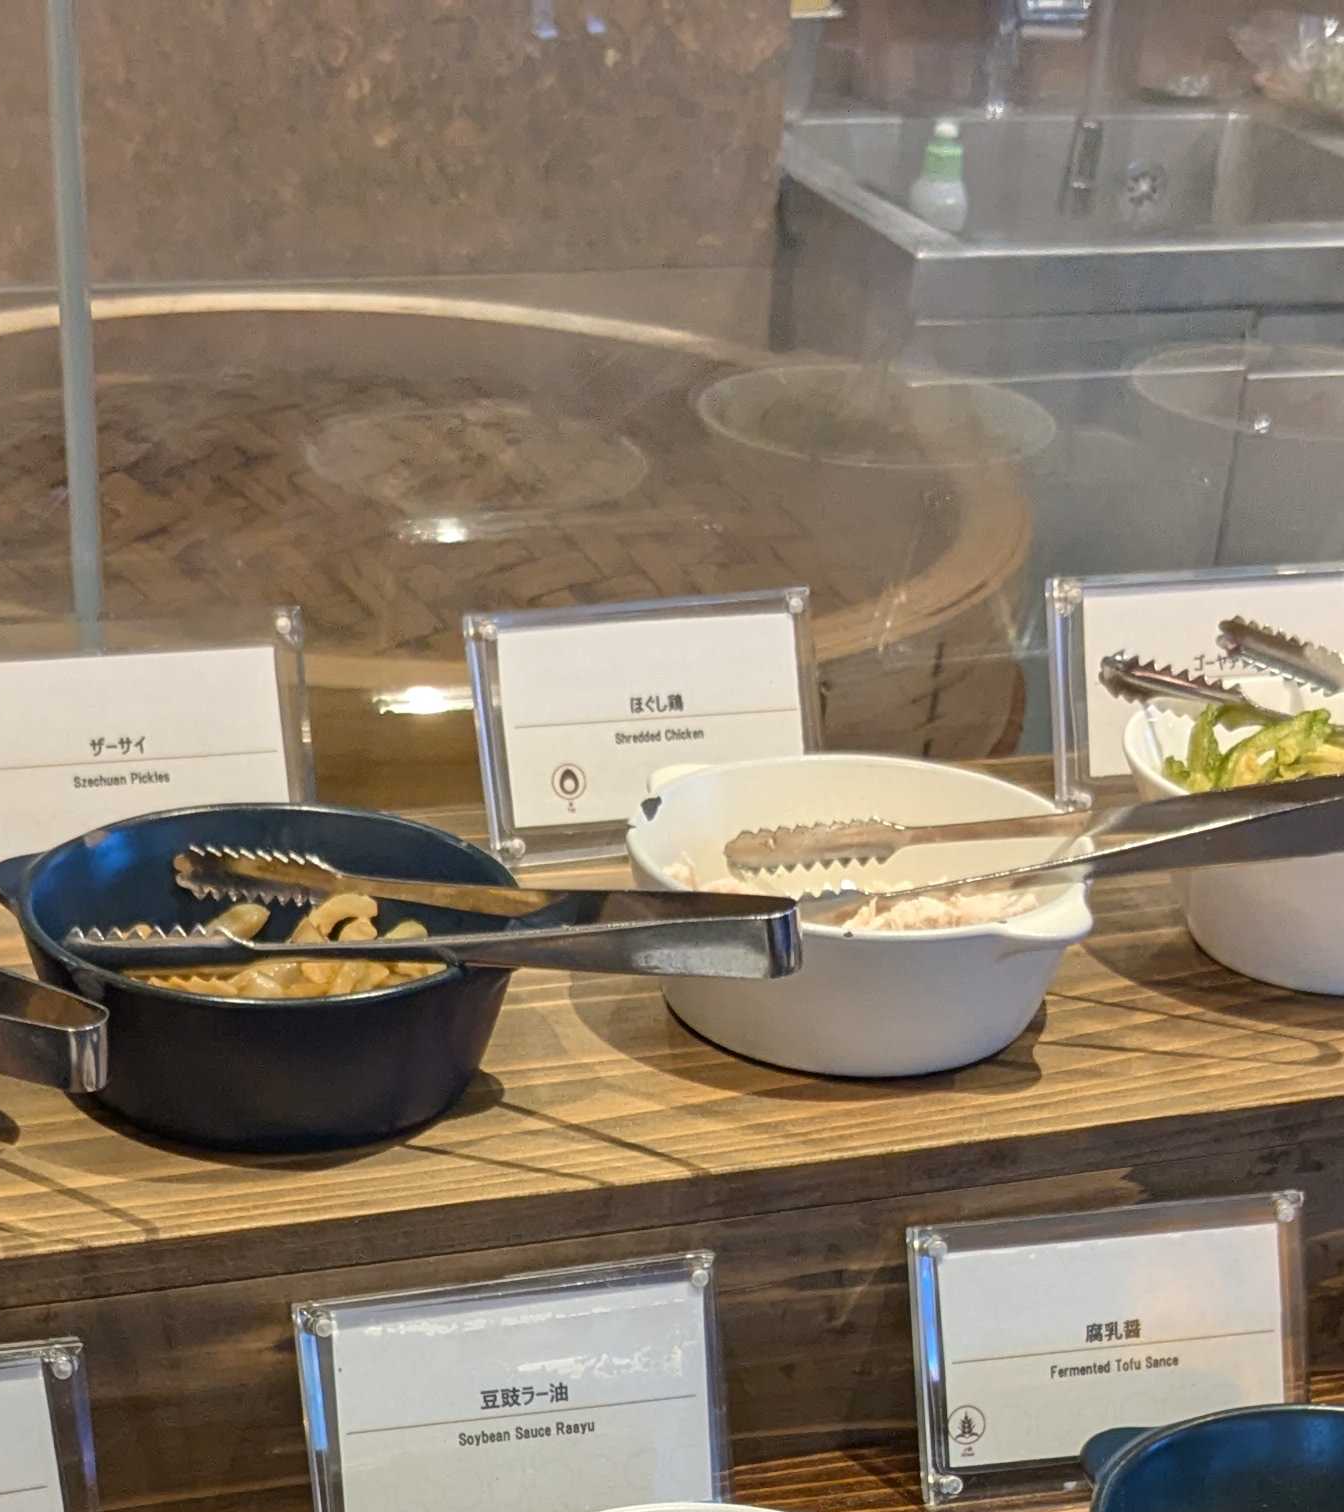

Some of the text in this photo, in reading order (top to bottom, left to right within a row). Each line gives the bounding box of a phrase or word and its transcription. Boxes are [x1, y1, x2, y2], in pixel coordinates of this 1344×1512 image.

[629, 693, 684, 714] ほぐし鶏
[615, 728, 704, 744] Shredded Chicken
[89, 736, 145, 757] ザーサイ
[73, 771, 170, 788] Szechuan Pickles
[1050, 1361, 1111, 1379] Fermented
[1115, 1359, 1142, 1372] Tofu
[458, 1421, 596, 1447] Soybean Sauce Raayu
